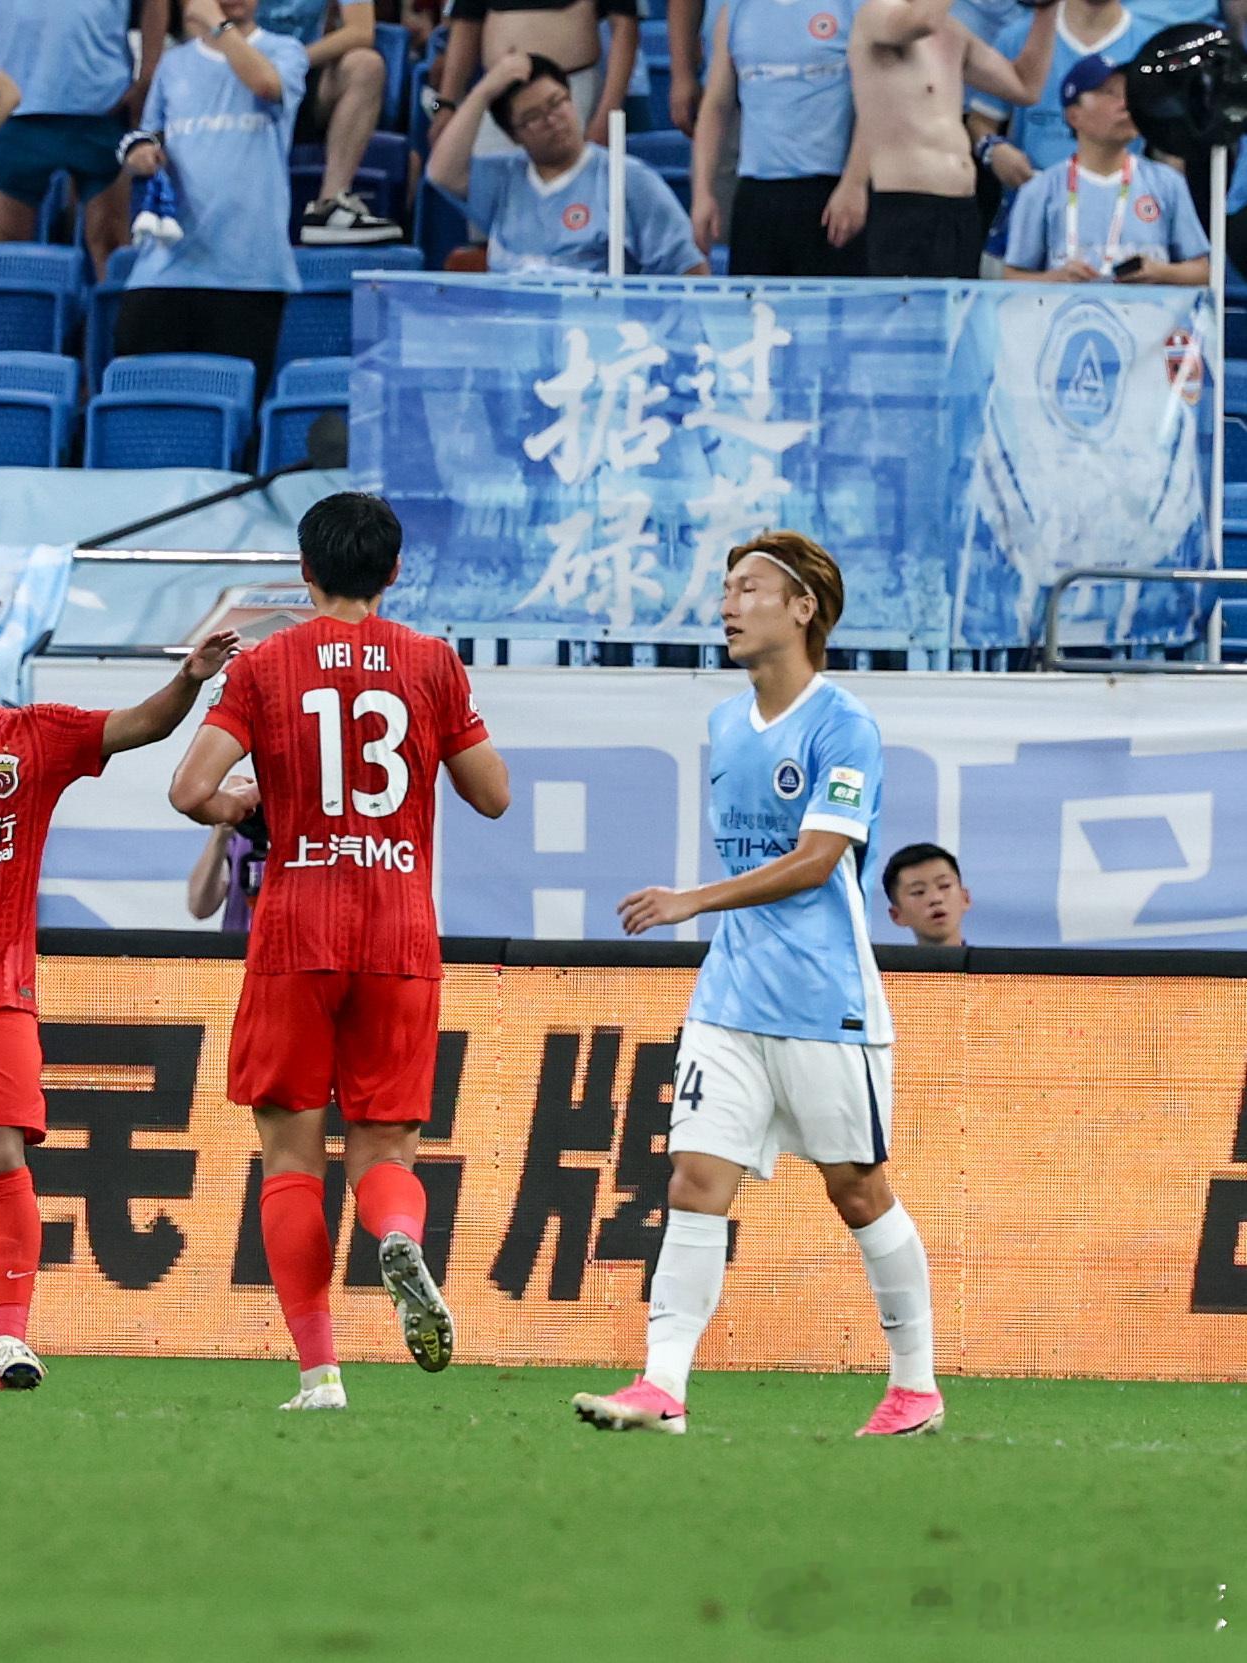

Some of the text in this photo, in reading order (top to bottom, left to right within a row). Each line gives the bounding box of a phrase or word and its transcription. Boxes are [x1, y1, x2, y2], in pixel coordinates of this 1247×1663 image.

[317, 643, 392, 672] WEI ZH.
[302, 687, 409, 818] 13
[284, 833, 415, 873] 上汽MG
